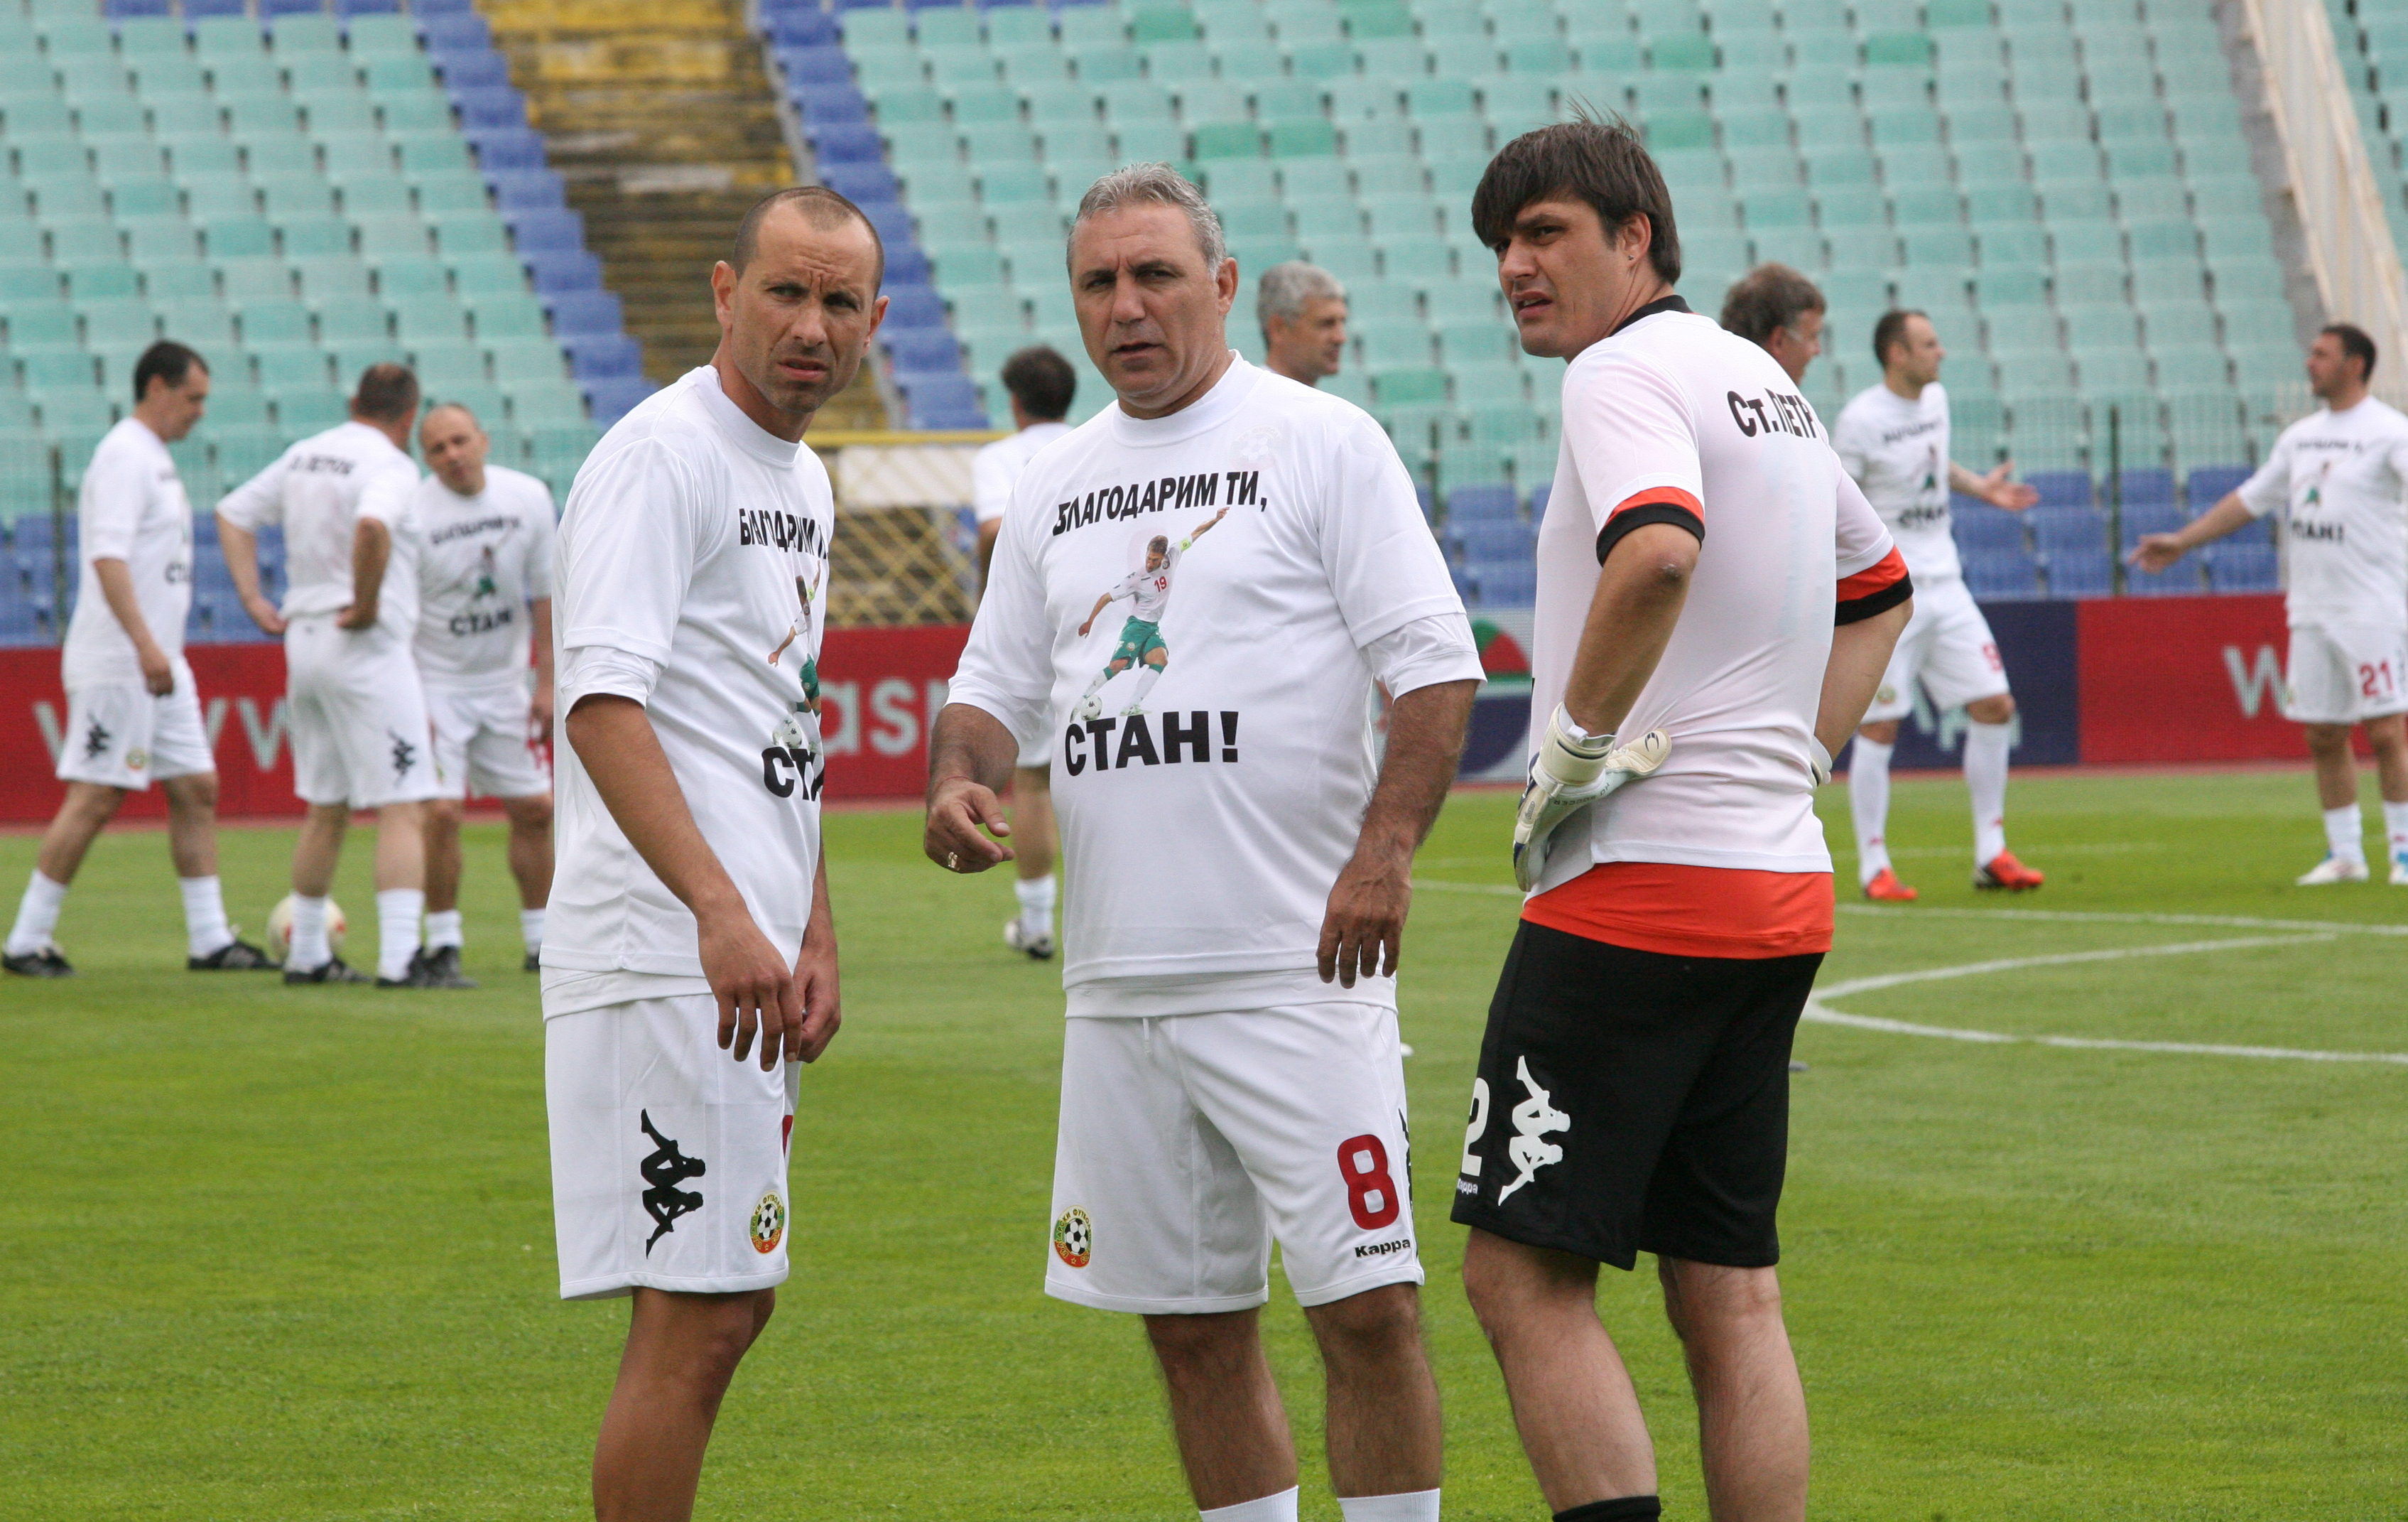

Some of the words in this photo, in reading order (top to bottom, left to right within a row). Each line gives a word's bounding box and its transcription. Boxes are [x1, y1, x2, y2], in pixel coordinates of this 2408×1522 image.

[1053, 473, 1219, 536] БЛАГОДАРИМ
[1226, 470, 1268, 512] ТИ,
[1154, 576, 1168, 593] 19
[2359, 658, 2394, 698] 21
[1065, 711, 1239, 776] СТАН!
[1337, 1134, 1399, 1230] 8
[1355, 1238, 1411, 1258] Kappa
